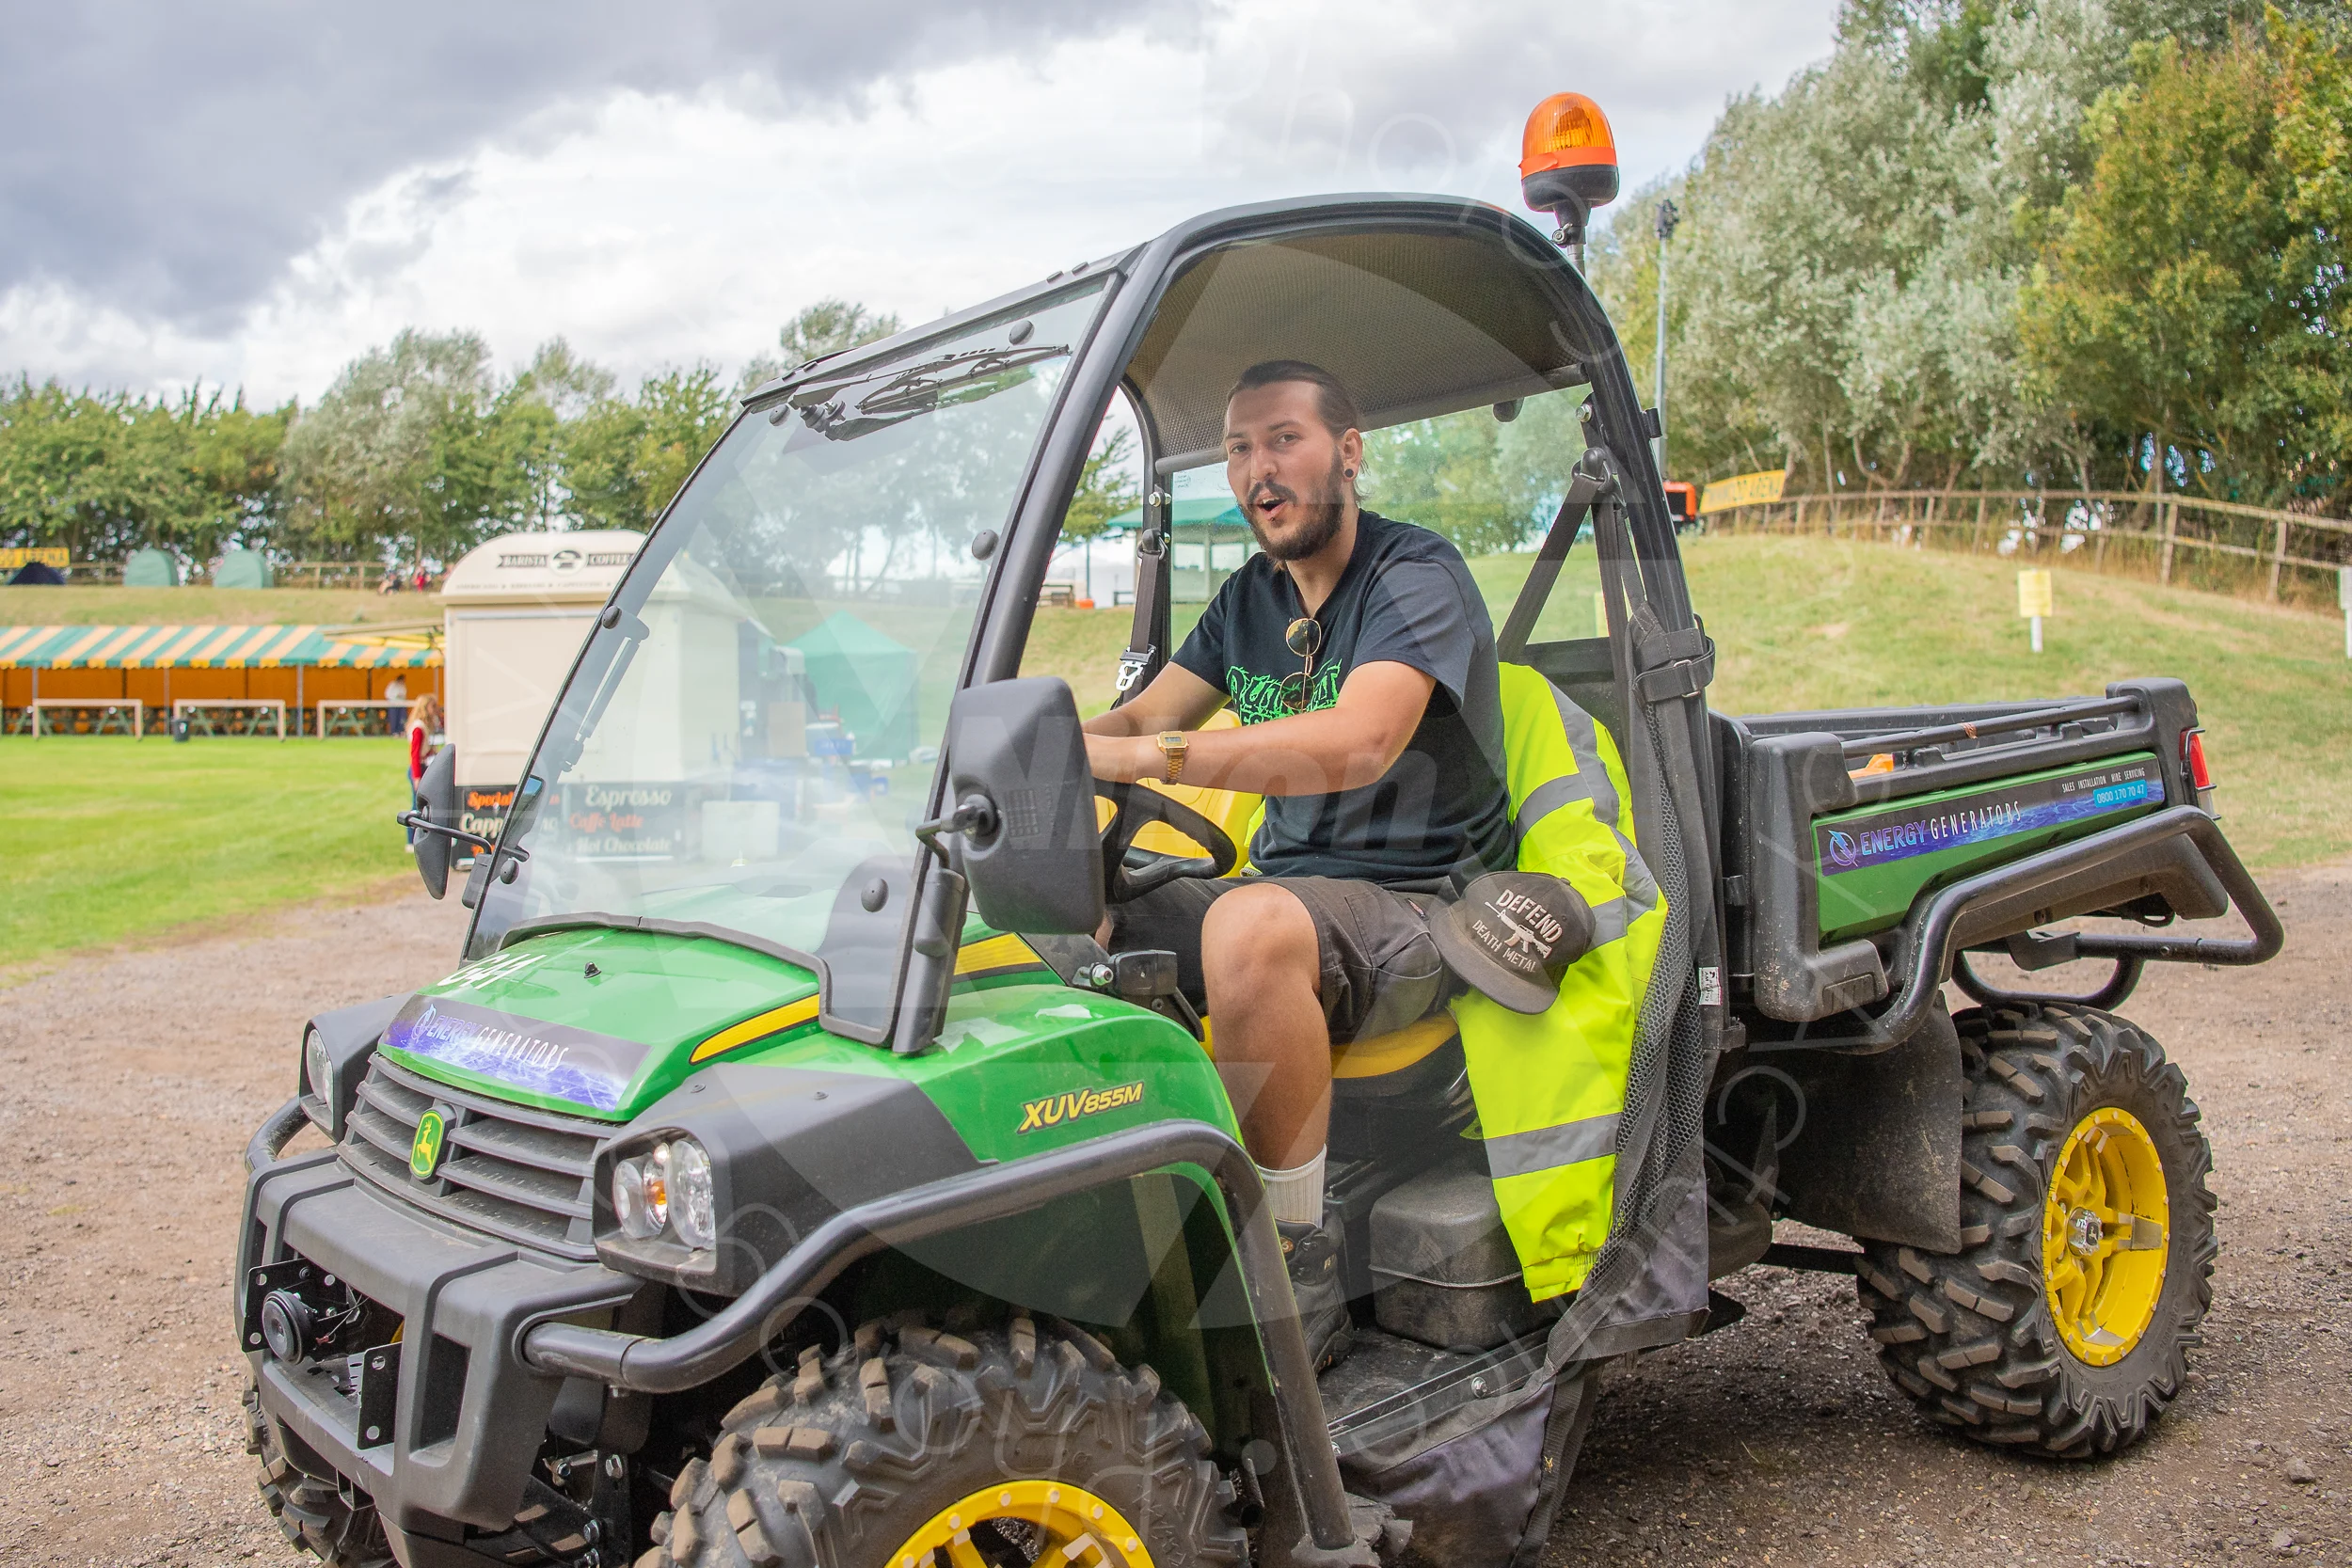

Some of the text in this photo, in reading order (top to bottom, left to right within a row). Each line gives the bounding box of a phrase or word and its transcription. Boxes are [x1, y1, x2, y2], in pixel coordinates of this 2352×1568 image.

[502, 555, 547, 566] BARISTA
[2061, 767, 2146, 793] SALES INSTALLATION HIRE SERVICING
[2096, 784, 2145, 804] 0800 170 70 47
[584, 784, 673, 812] Espresso
[610, 813, 644, 833] Latte
[1859, 800, 2022, 856] ENERGY GENERATORS
[576, 834, 671, 854] Hot Chocolate
[1495, 888, 1563, 943] DEFEND
[1471, 919, 1537, 973] DEATH METAL
[427, 1014, 569, 1071] ENERGY GENERATORS
[1017, 1082, 1144, 1134] XUV855M
